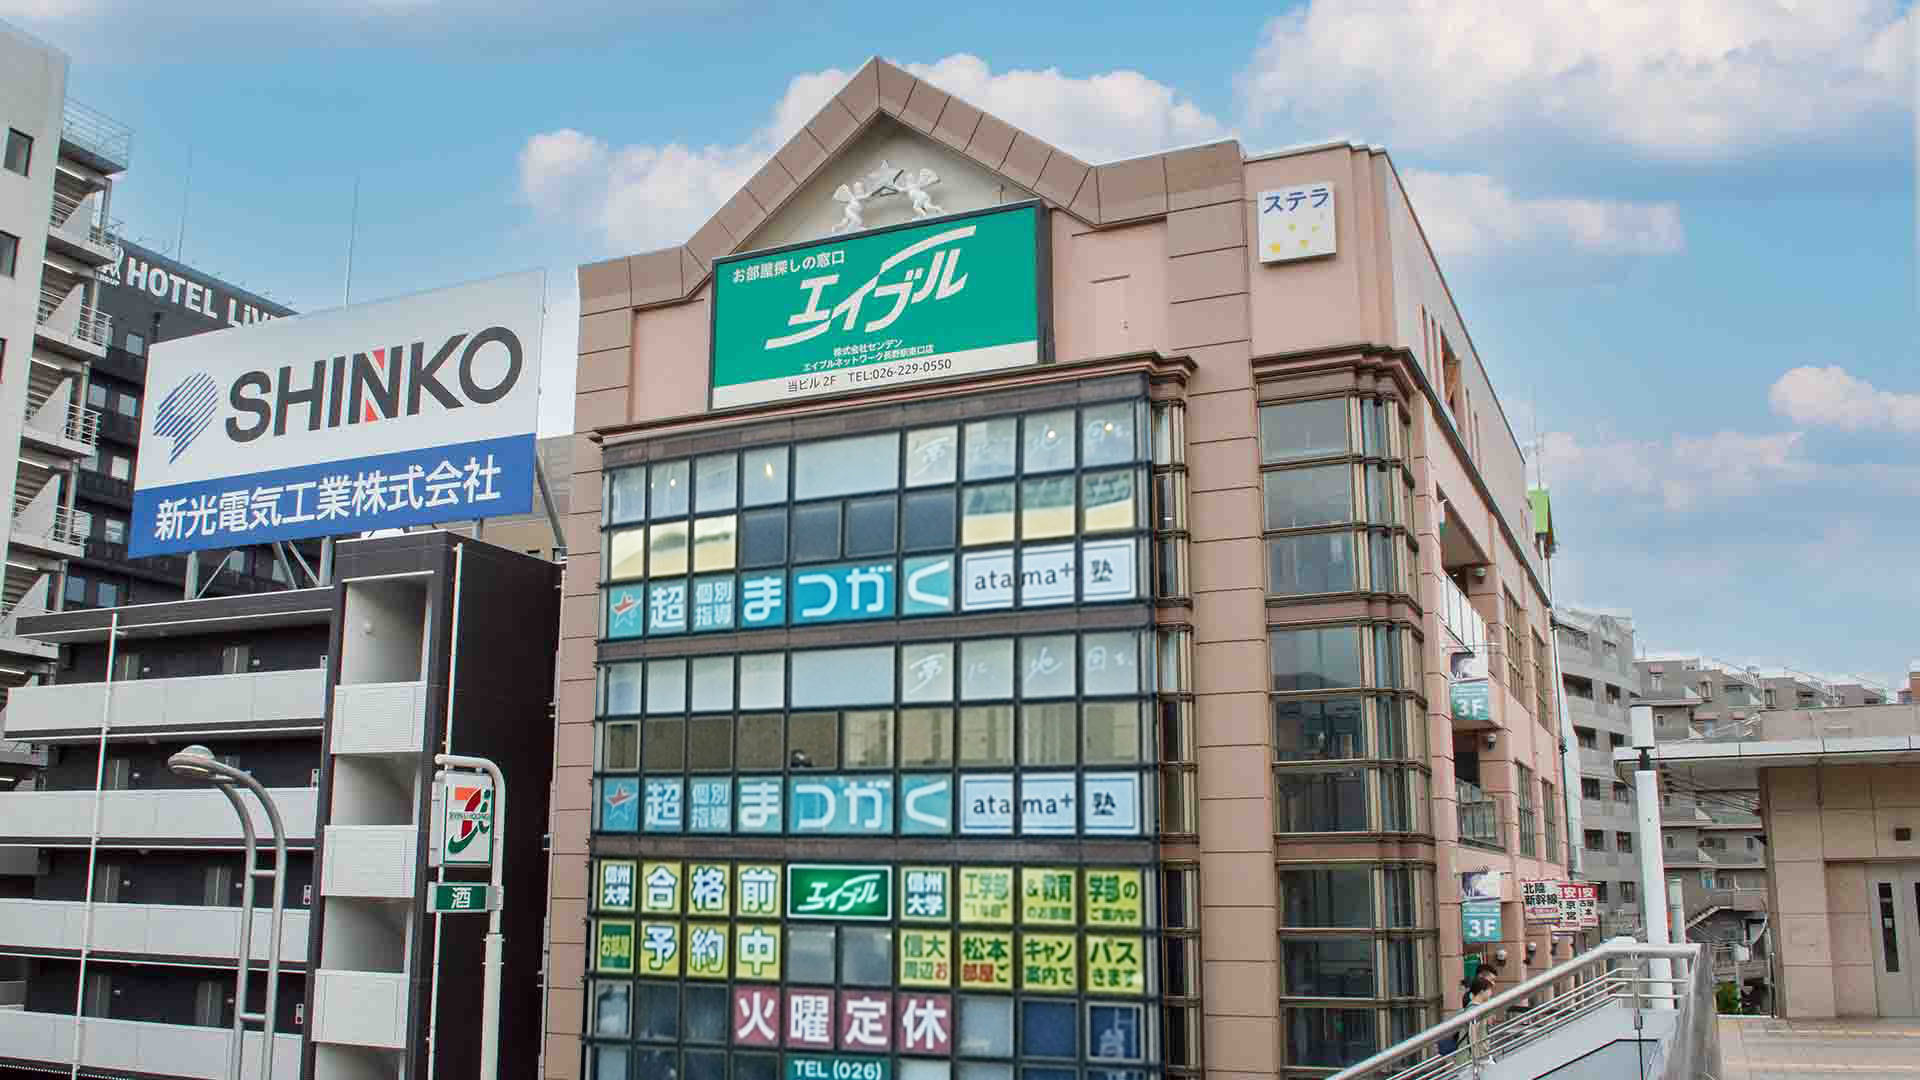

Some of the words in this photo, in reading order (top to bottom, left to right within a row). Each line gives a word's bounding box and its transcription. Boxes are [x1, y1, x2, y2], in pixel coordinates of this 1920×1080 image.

[1264, 188, 1329, 214] ステラ
[127, 256, 217, 319] HOTEL
[732, 250, 845, 282] お部屋探しの窓口
[764, 225, 977, 350] エイブル
[225, 326, 523, 443] SHINKO
[788, 377, 819, 393] 当ビル
[823, 375, 837, 387] 2F
[848, 359, 952, 383] TEL:026-229-0550
[154, 454, 502, 541] 新光電気工業株式会社
[743, 560, 949, 622] まつがく
[974, 562, 1075, 591] atama+
[1091, 559, 1113, 584] 塾
[1457, 699, 1485, 718] 3F
[740, 780, 947, 829] まつがく
[973, 791, 1073, 815] atama+
[1092, 792, 1117, 816] 塾
[451, 887, 472, 909] 酒
[646, 866, 778, 914] 合格前
[797, 874, 881, 912] エイブル
[643, 925, 777, 976] 予約中
[1469, 919, 1497, 938] 3F
[737, 992, 949, 1050] 火曜定休
[794, 1060, 829, 1078] TEL
[833, 1059, 882, 1080] (026)
